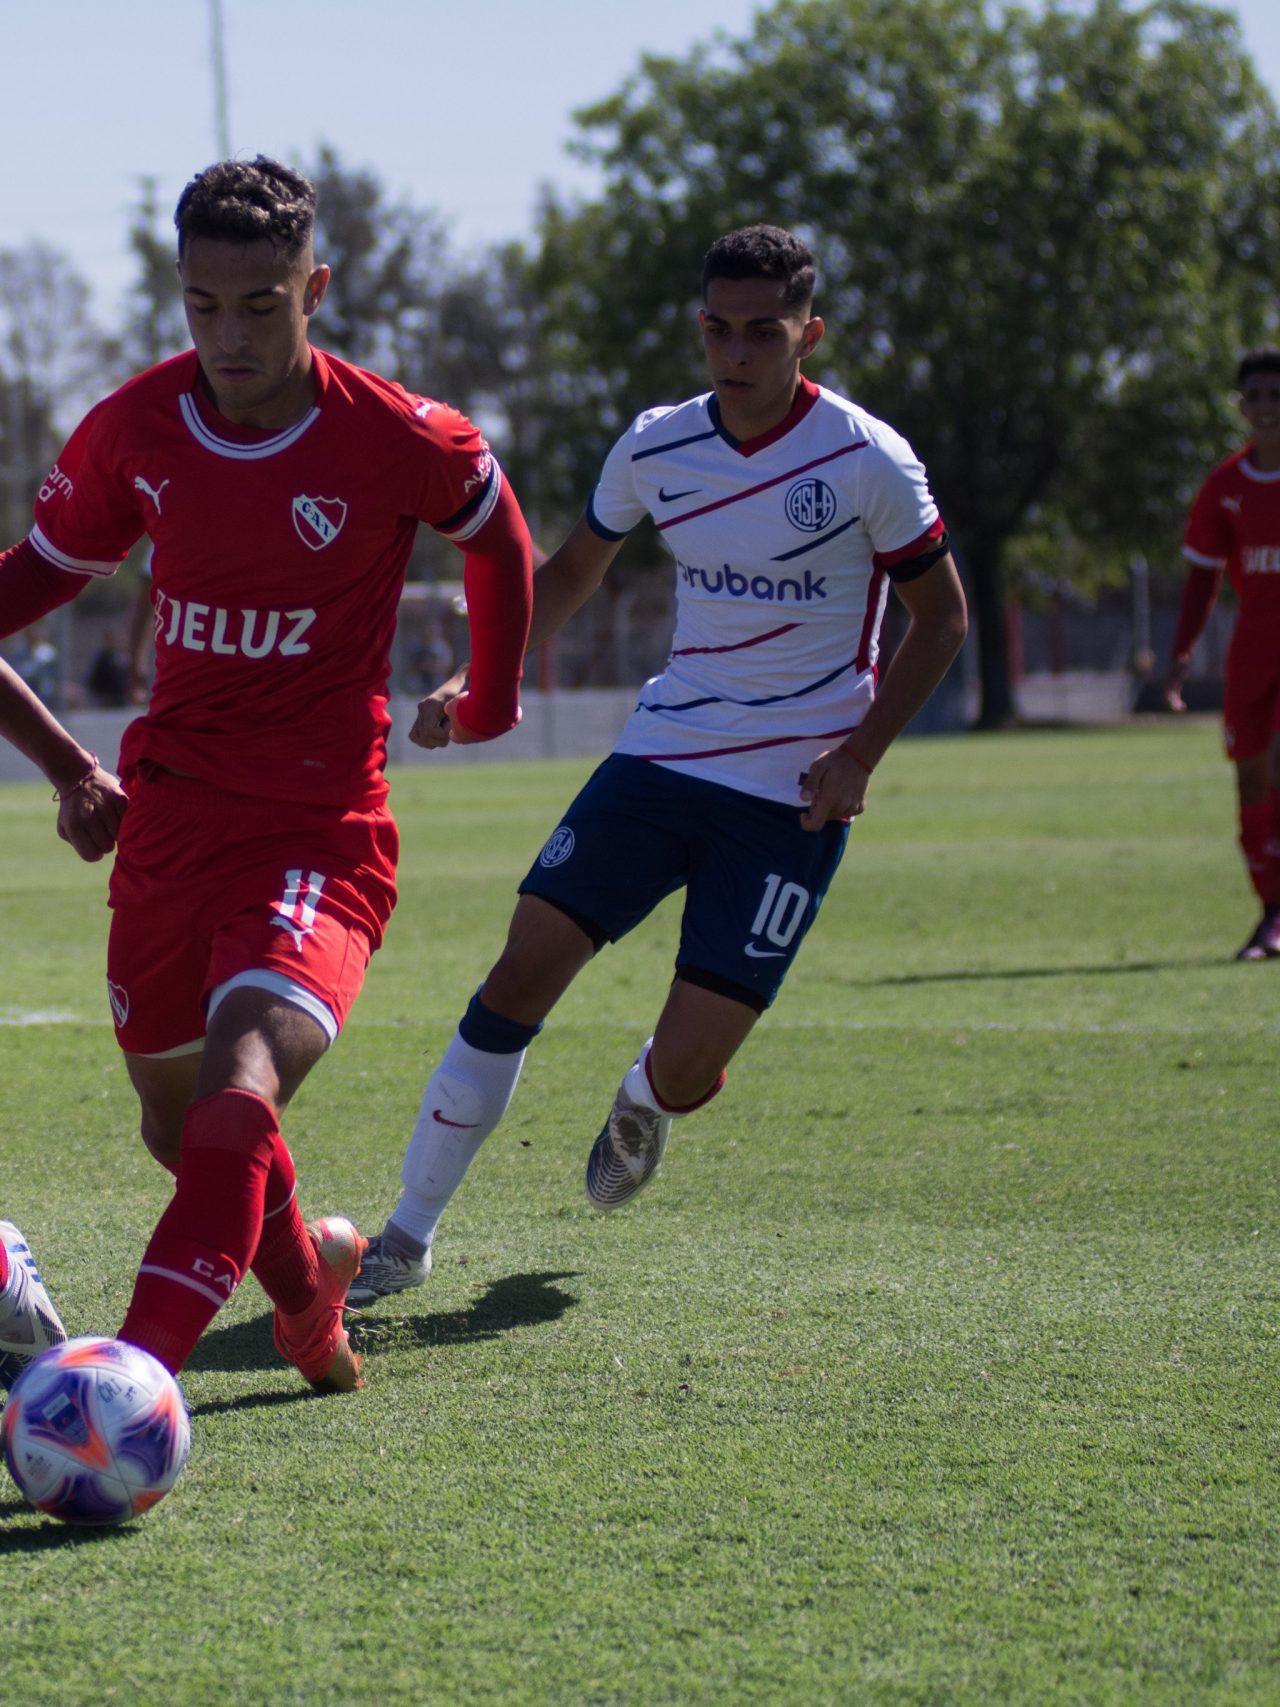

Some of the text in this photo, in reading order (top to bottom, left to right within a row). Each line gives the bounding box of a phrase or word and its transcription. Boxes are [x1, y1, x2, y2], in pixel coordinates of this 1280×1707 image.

[164, 597, 318, 660] JELUZ
[279, 868, 327, 928] 11
[749, 872, 810, 948] 10
